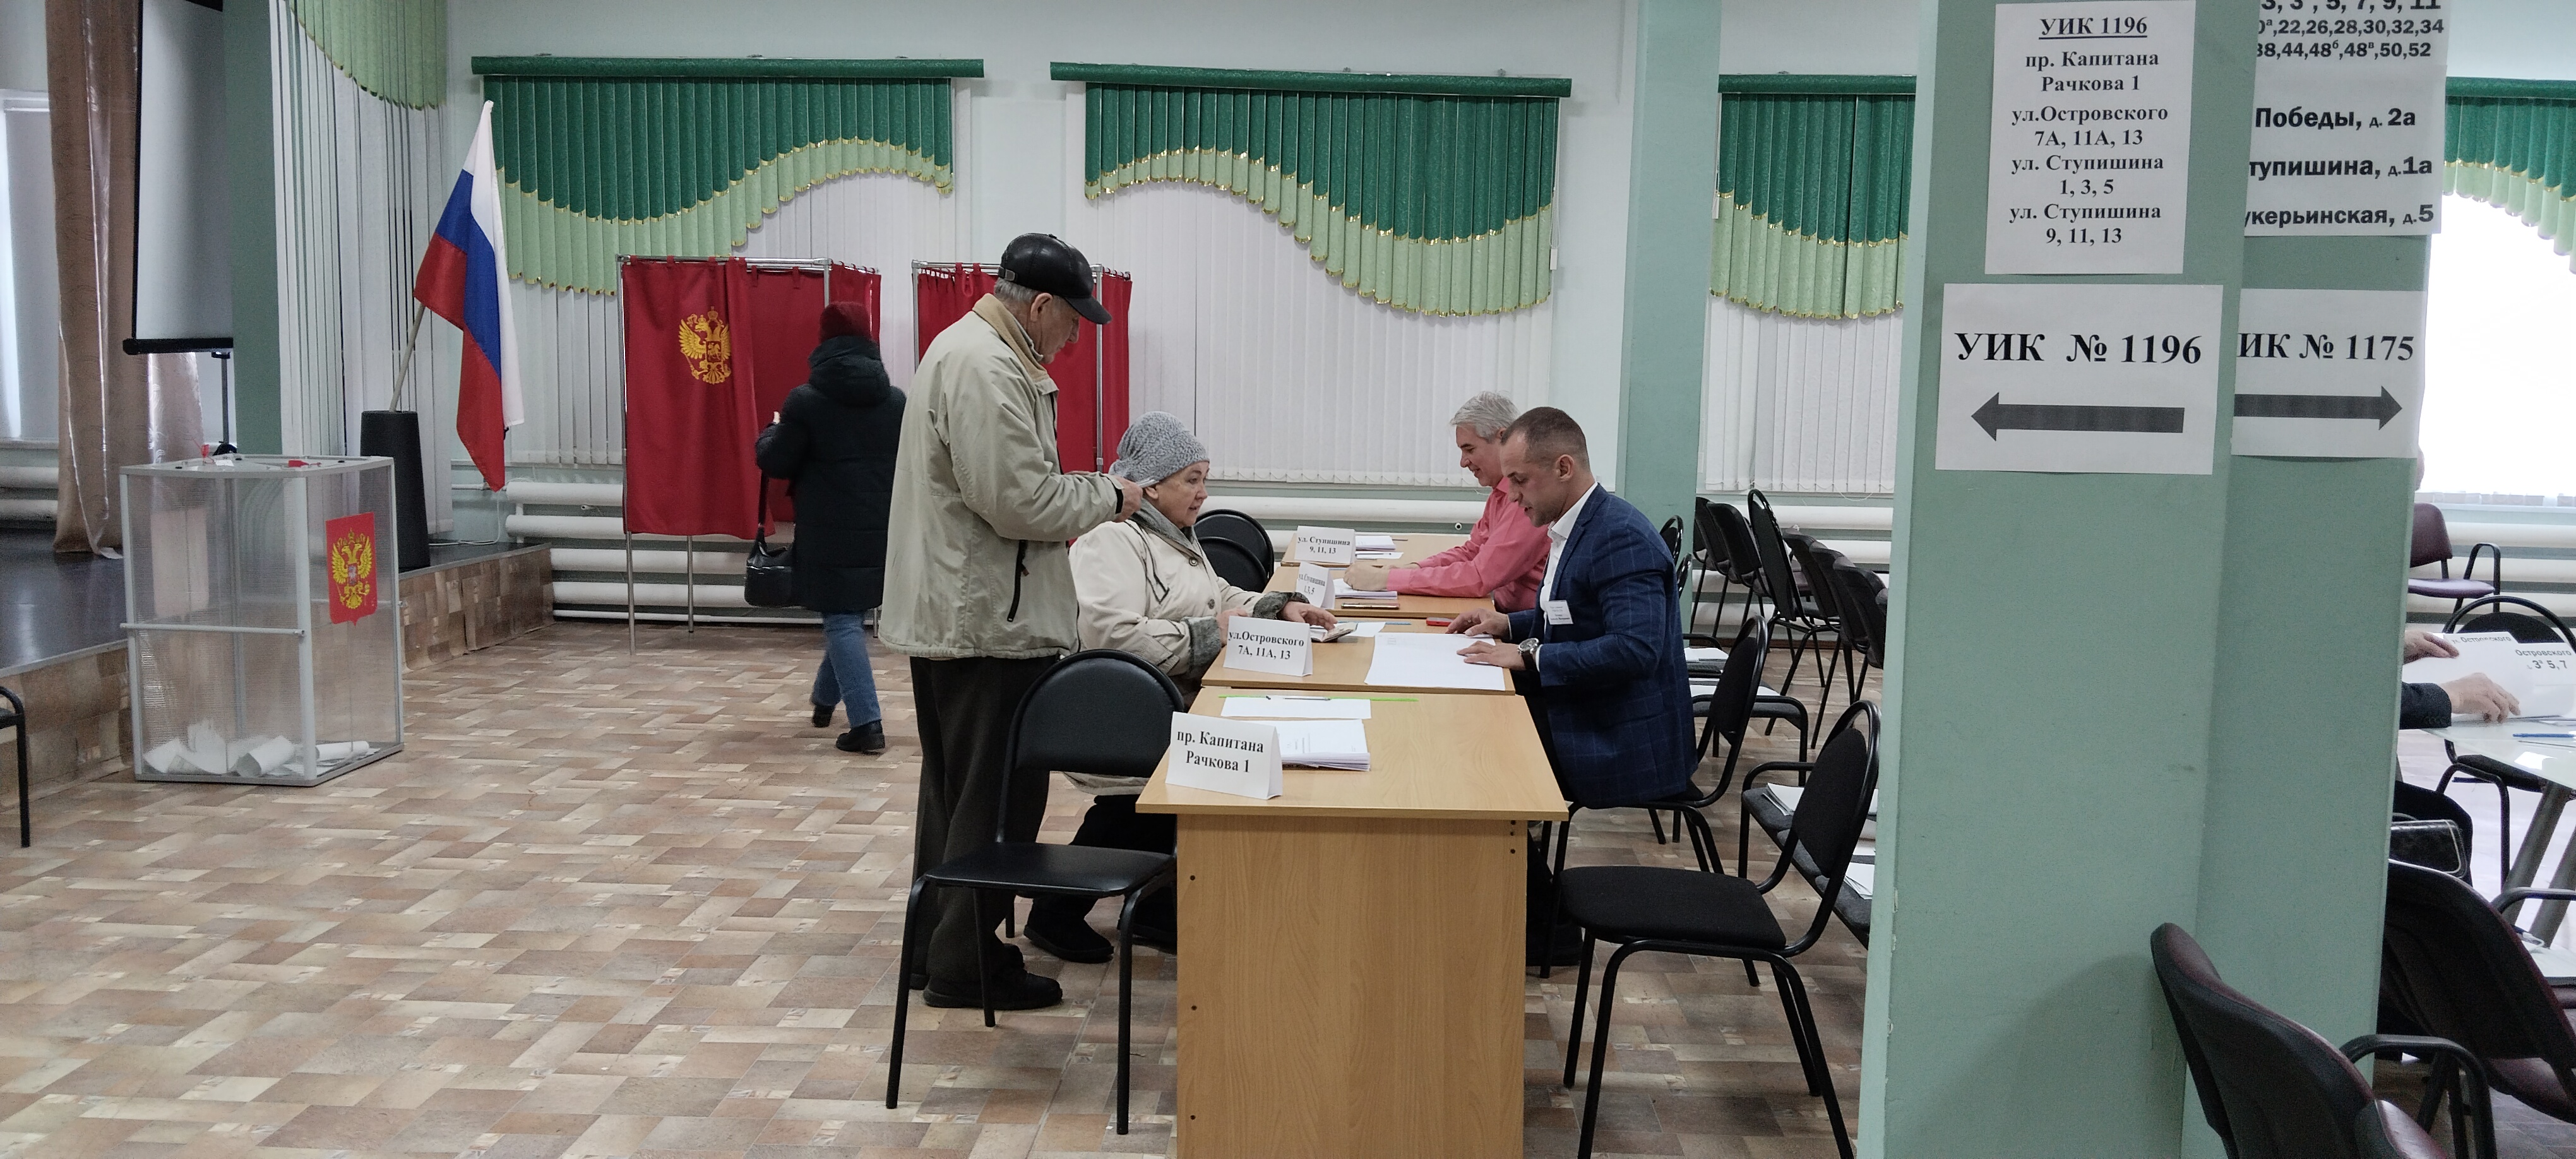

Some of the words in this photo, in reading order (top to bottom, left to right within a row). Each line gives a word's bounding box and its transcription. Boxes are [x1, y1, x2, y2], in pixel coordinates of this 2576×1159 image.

[2039, 18, 2094, 35] УИК
[2101, 16, 2148, 34] 1196
[2025, 55, 2055, 71] пр.
[2061, 51, 2159, 67] Капитана
[2041, 76, 2125, 92] Рачкова
[2132, 75, 2140, 90] 1
[2255, 106, 2362, 131] Победы,
[2369, 117, 2383, 128] д.
[2387, 108, 2416, 126] 2а
[2034, 130, 2066, 148] 7А,
[2073, 129, 2116, 148] 11А,
[2123, 129, 2144, 145] 13
[2012, 158, 2040, 174] ул.
[2046, 155, 2164, 175] Ступишина
[2060, 179, 2075, 197] 1,
[2080, 179, 2097, 197] 3,
[2103, 179, 2114, 194] 5
[2009, 207, 2037, 223] ул.
[2044, 203, 2161, 223] Ступишина
[2046, 228, 2062, 246] 9,
[2069, 228, 2095, 246] 11,
[2102, 227, 2122, 244] 13
[1953, 332, 2046, 361] УИК
[2066, 334, 2108, 363] №
[2121, 334, 2203, 364] 1196
[2298, 334, 2335, 360] №
[2346, 334, 2414, 361] 1175
[1309, 536, 1351, 546] Ступишина
[1237, 645, 1253, 657] 7А,
[1256, 647, 1277, 660] 11А,
[1280, 650, 1291, 660] 13
[2515, 649, 2572, 657] Островского
[1177, 730, 1195, 746] пр.
[1199, 730, 1264, 753] Капитана
[1186, 749, 1239, 771] Рачкова
[1243, 759, 1250, 773] 1
